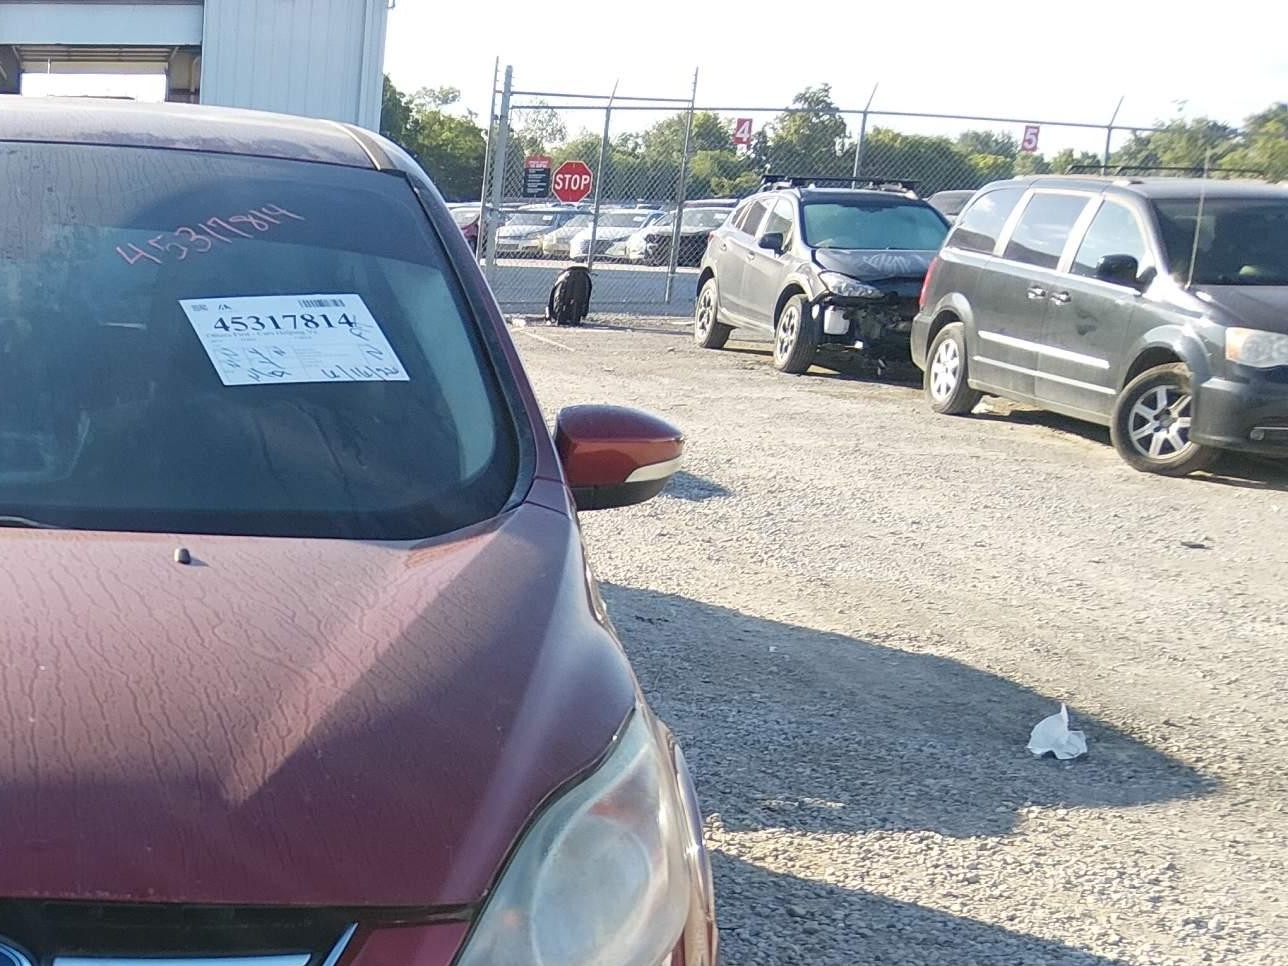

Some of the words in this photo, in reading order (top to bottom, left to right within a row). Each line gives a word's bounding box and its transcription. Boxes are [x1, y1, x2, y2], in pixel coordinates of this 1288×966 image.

[735, 120, 750, 142] 4
[1023, 127, 1038, 150] 5
[554, 173, 591, 191] STOP
[116, 203, 305, 265] 45317814
[214, 312, 354, 331] 45317814
